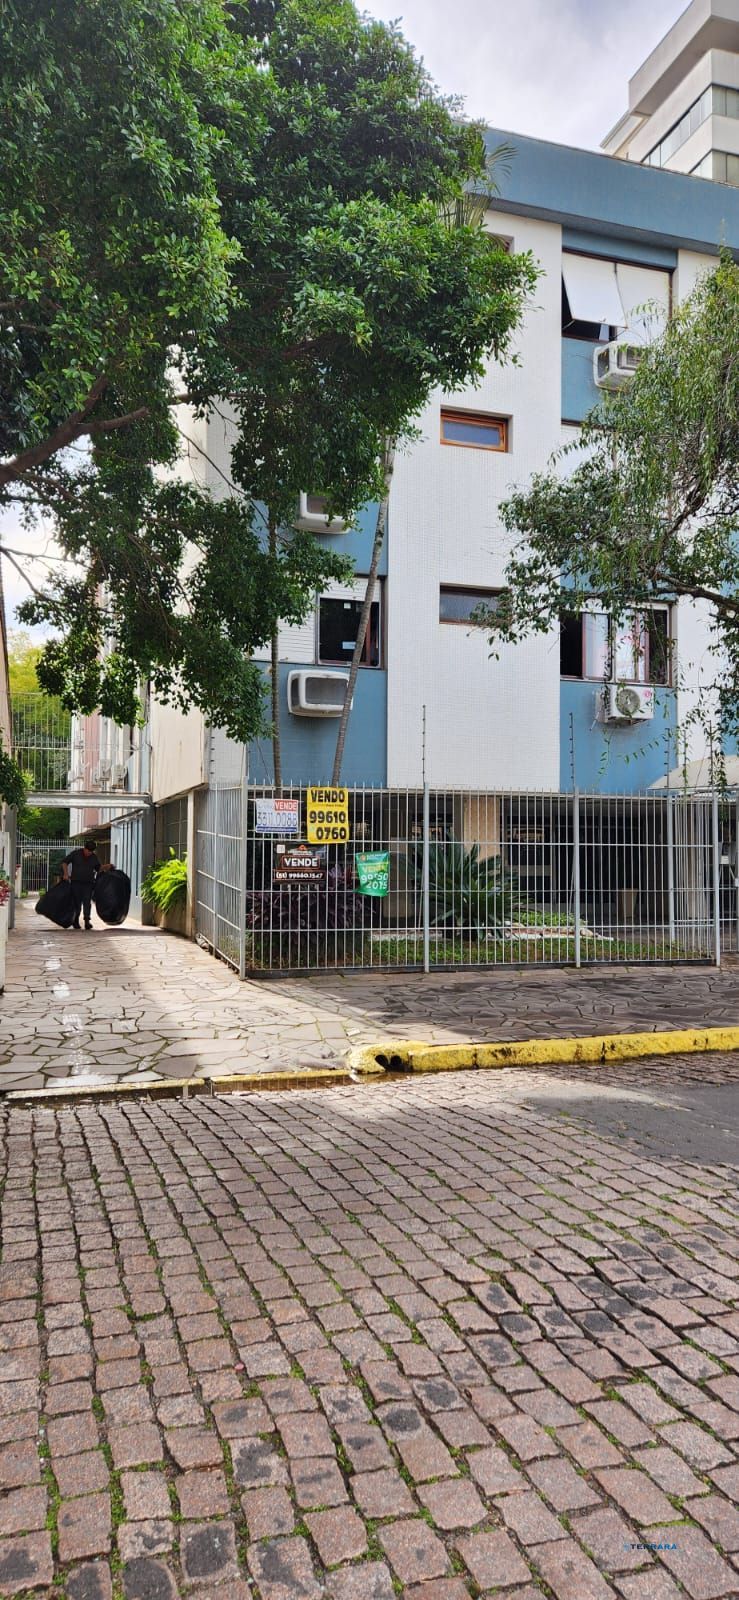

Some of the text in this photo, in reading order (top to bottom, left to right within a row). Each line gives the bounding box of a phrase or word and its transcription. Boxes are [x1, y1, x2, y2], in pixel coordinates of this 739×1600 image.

[310, 789, 345, 803] VENDO
[275, 801, 297, 810] VENDE
[309, 810, 346, 824] 99610
[316, 826, 347, 840] 0760
[284, 857, 318, 867] VENDE
